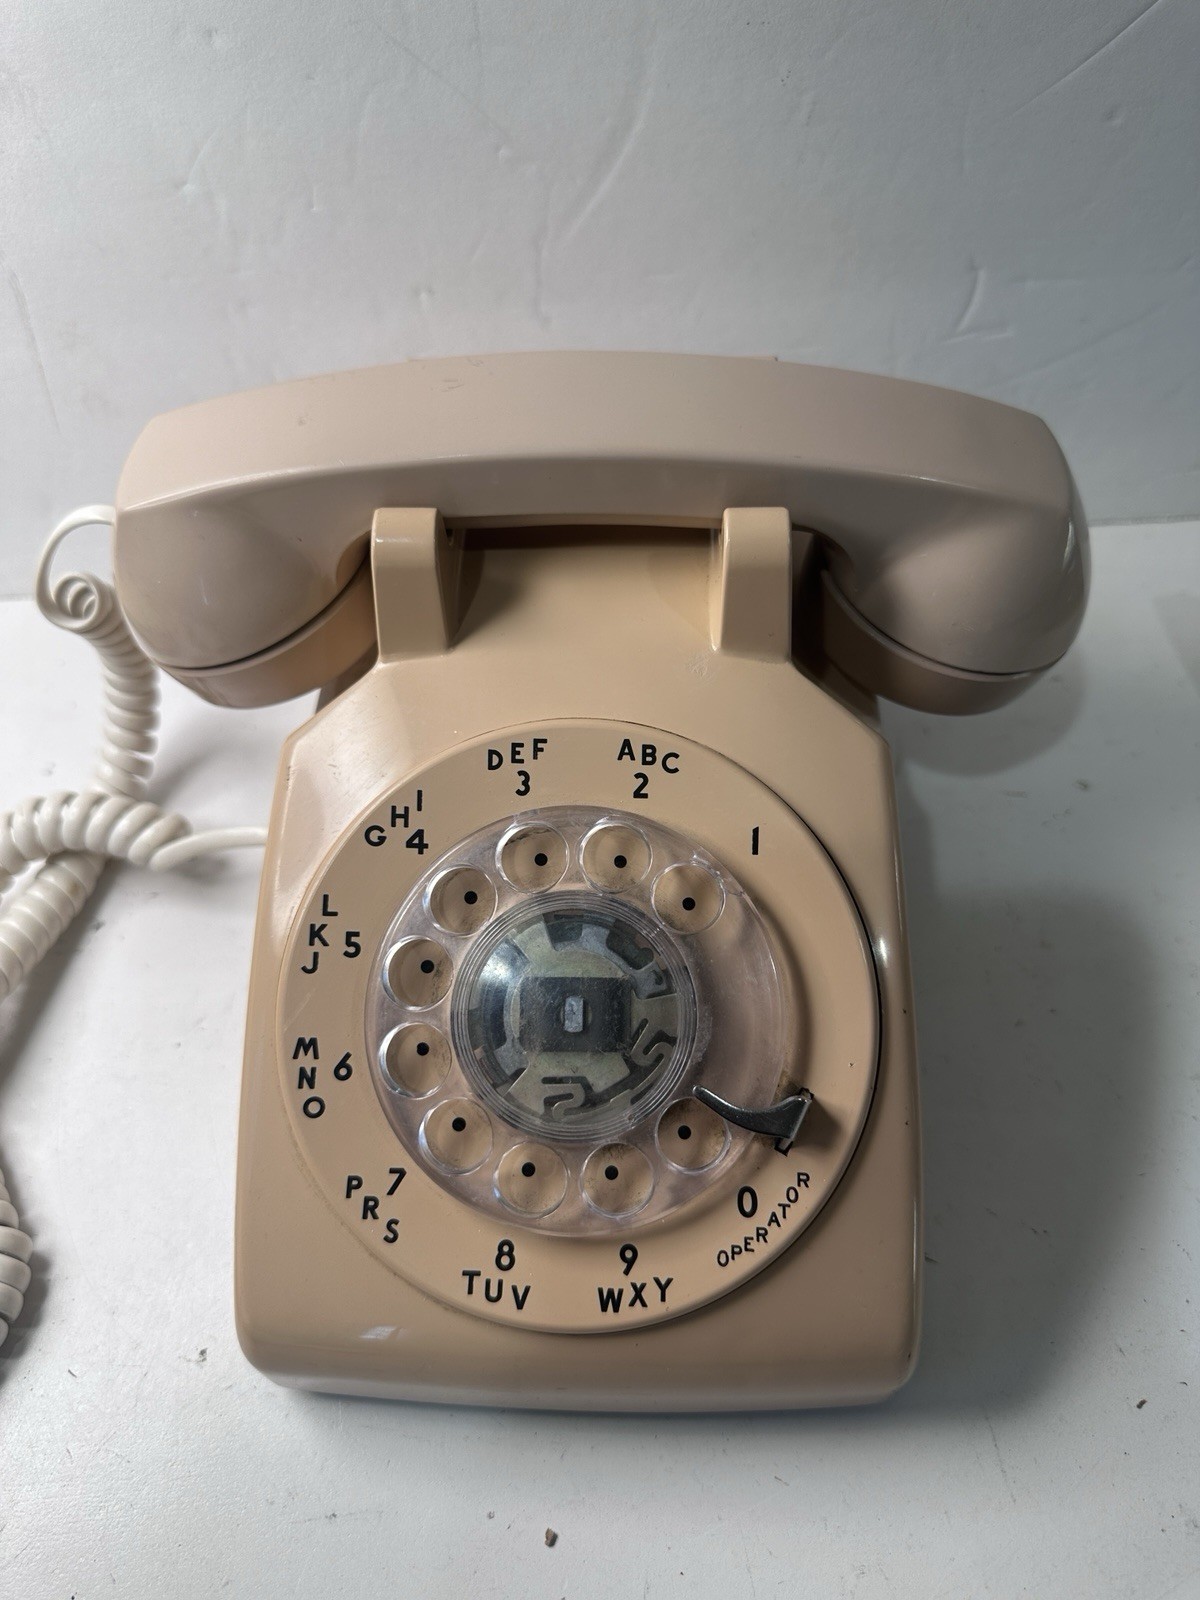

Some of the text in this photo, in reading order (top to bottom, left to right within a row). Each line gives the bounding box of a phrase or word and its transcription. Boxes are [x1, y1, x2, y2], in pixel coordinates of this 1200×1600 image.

[487, 738, 548, 770] DEF
[617, 738, 680, 774] ABC
[515, 770, 531, 796] 3
[632, 772, 649, 799] 2
[364, 789, 423, 847] GHI
[405, 829, 429, 855] 4
[752, 826, 760, 856] 1
[343, 931, 362, 958] 5
[292, 1036, 326, 1119] MNO
[333, 1052, 353, 1081] 6
[386, 1167, 407, 1196] 7
[345, 1175, 400, 1244] PRS
[737, 1185, 759, 1218] 0
[716, 1172, 811, 1268] OPERATOR
[495, 1238, 516, 1272] 8
[619, 1243, 639, 1277] 9
[462, 1269, 531, 1310] TUV
[597, 1276, 674, 1314] WXY
